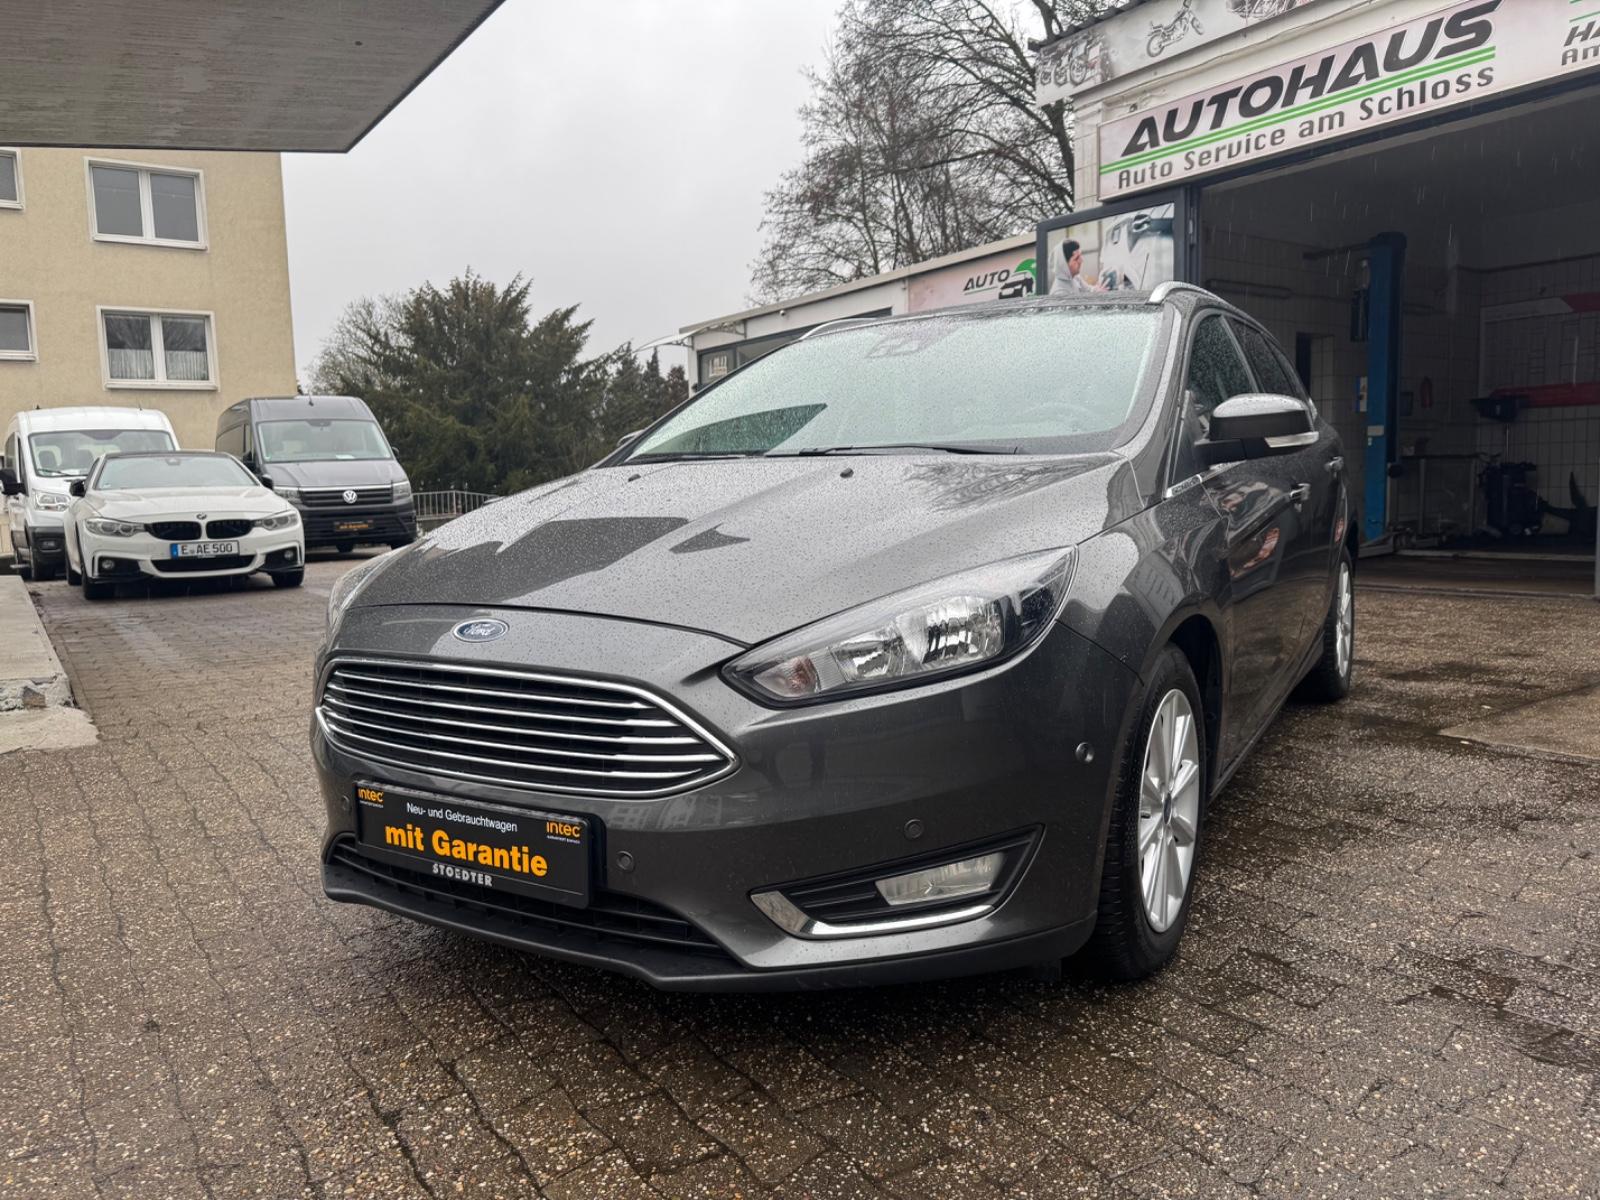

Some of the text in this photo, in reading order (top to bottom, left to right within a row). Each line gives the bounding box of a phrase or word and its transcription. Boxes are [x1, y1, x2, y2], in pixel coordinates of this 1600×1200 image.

[1121, 0, 1501, 157] AUTOHAUS
[1118, 66, 1495, 190] Auto Service am Schloss
[963, 269, 1010, 291] AUTO
[181, 542, 233, 555] E AE 500
[358, 788, 384, 803] intec
[406, 802, 518, 833] Neu- und Gebrauchtwagen
[546, 821, 581, 838] intec
[385, 823, 548, 877] mit Garantie
[432, 863, 493, 887] STOEDTER
